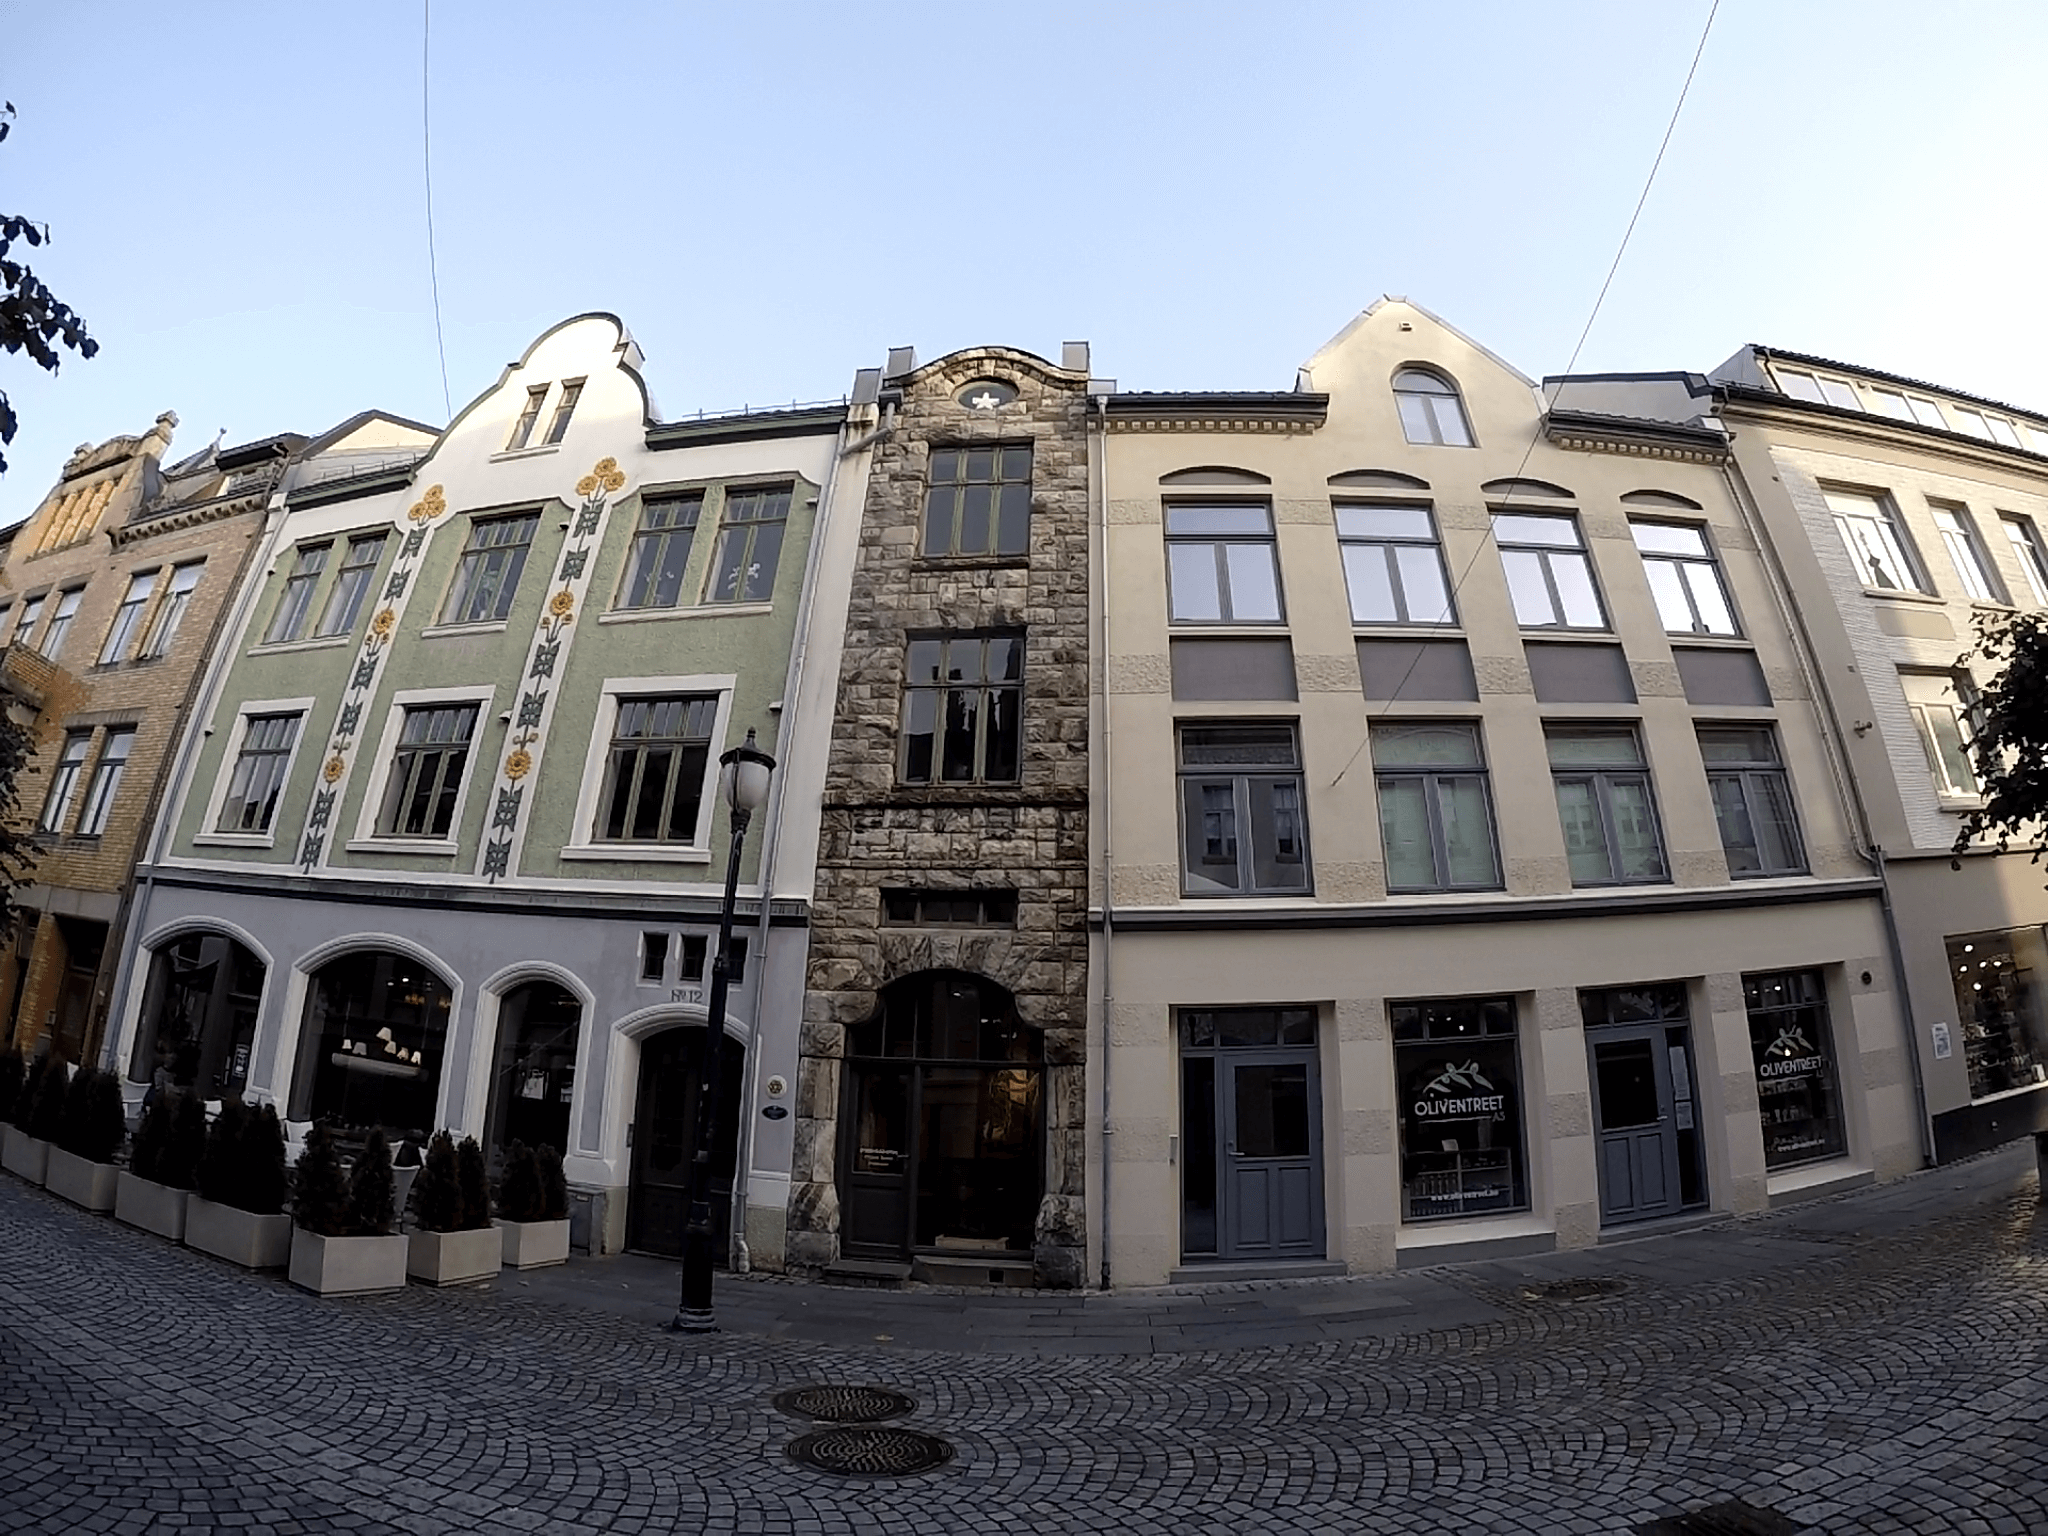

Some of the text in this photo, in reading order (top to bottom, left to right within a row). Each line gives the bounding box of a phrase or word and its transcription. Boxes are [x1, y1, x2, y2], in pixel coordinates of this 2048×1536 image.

[1760, 1055, 1822, 1077] OLIVENTREET
[1414, 1095, 1504, 1116] OLIVENTREET
[1492, 1111, 1506, 1122] AS
